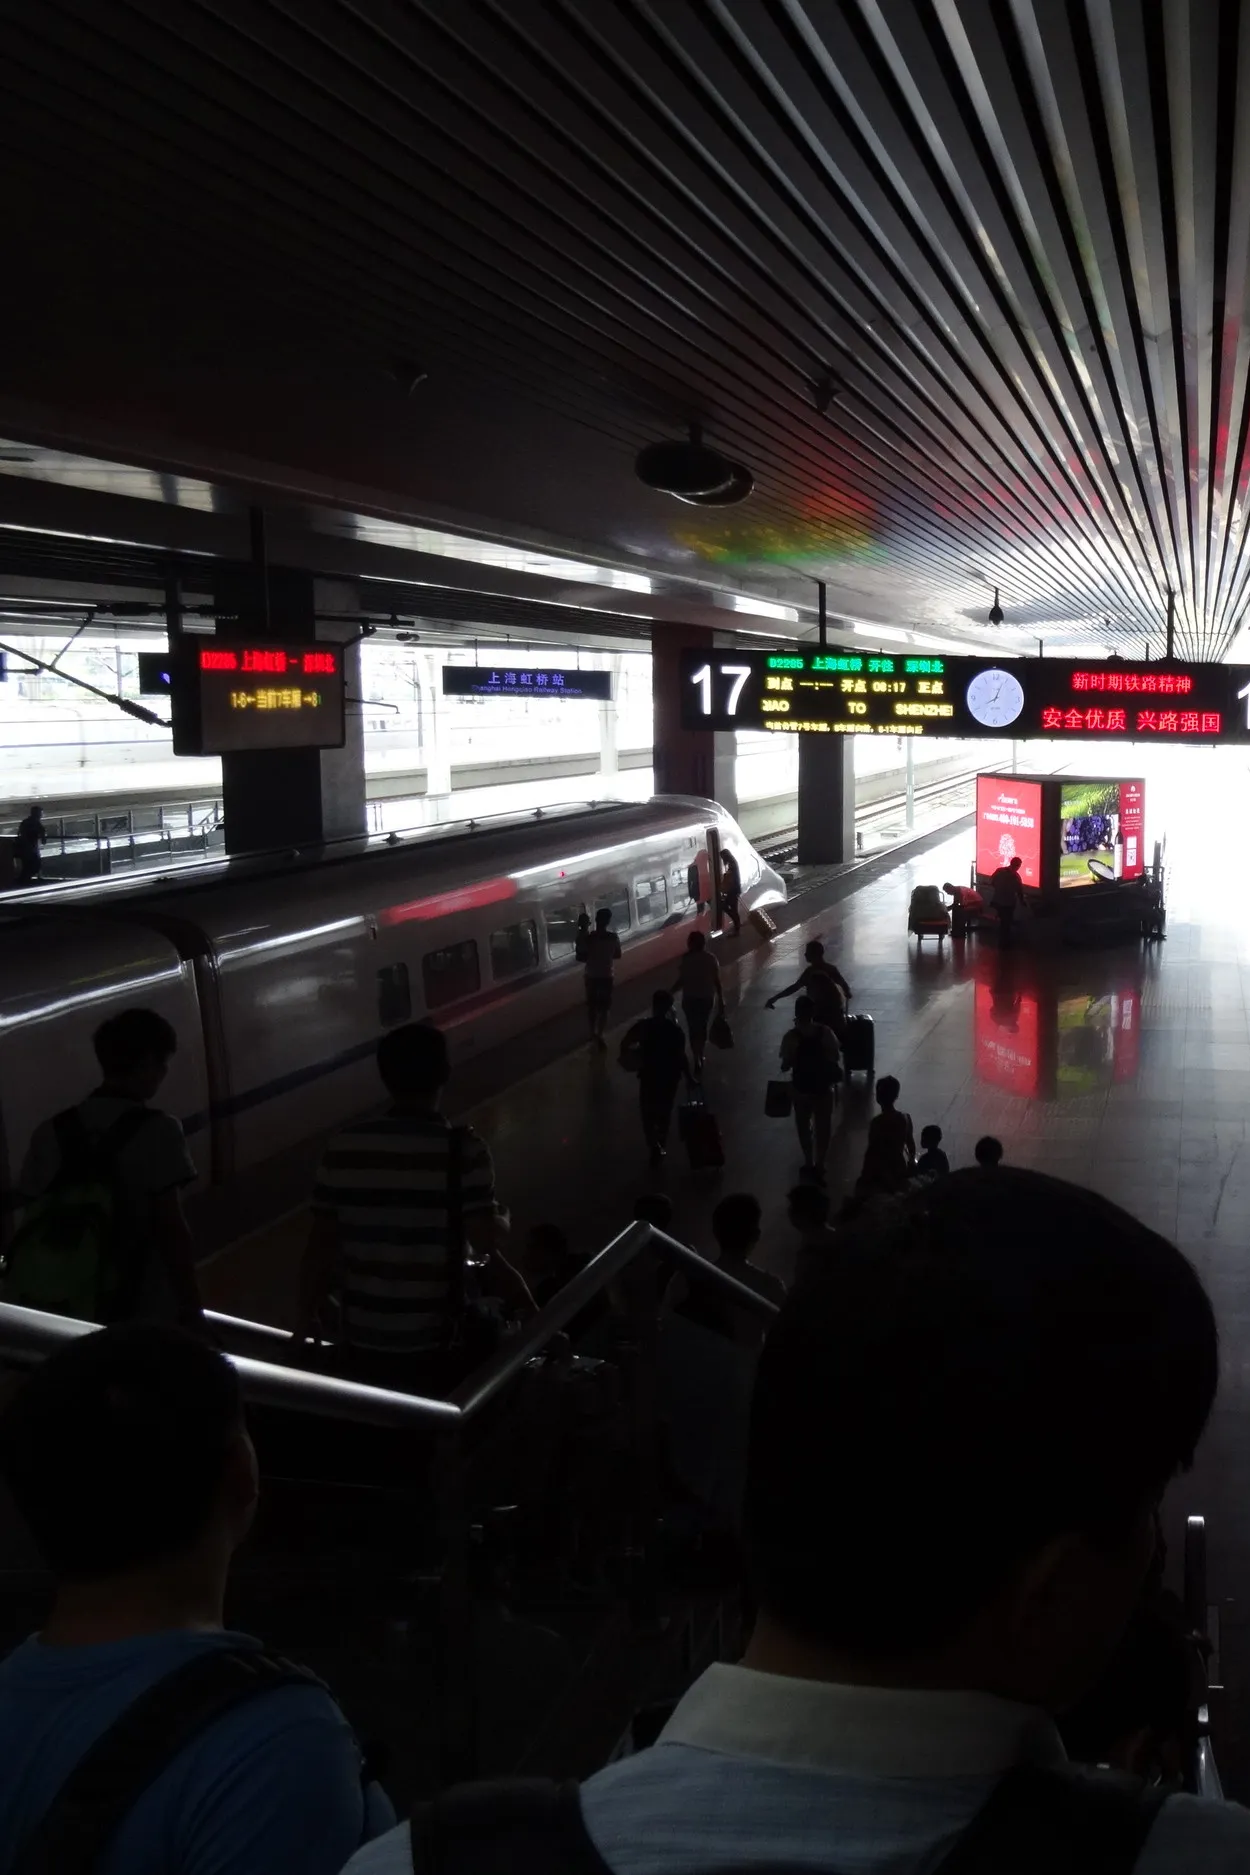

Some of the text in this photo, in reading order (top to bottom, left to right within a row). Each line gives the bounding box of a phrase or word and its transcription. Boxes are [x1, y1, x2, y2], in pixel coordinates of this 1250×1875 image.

[811, 656, 863, 671] 上海虹桥
[868, 658, 894, 672] 开往
[905, 659, 944, 673] 深圳北
[488, 671, 565, 687] 上海虹桥站
[766, 676, 794, 691] 到点
[840, 678, 867, 693] 开点
[917, 680, 944, 695] 正点
[1072, 671, 1192, 694] 新时期铁路精神
[533, 687, 558, 695] Railway
[691, 664, 752, 716] 17
[847, 702, 867, 714] TO
[894, 703, 954, 717] SHENZHE
[1042, 708, 1221, 733] 安全优质 兴路强国
